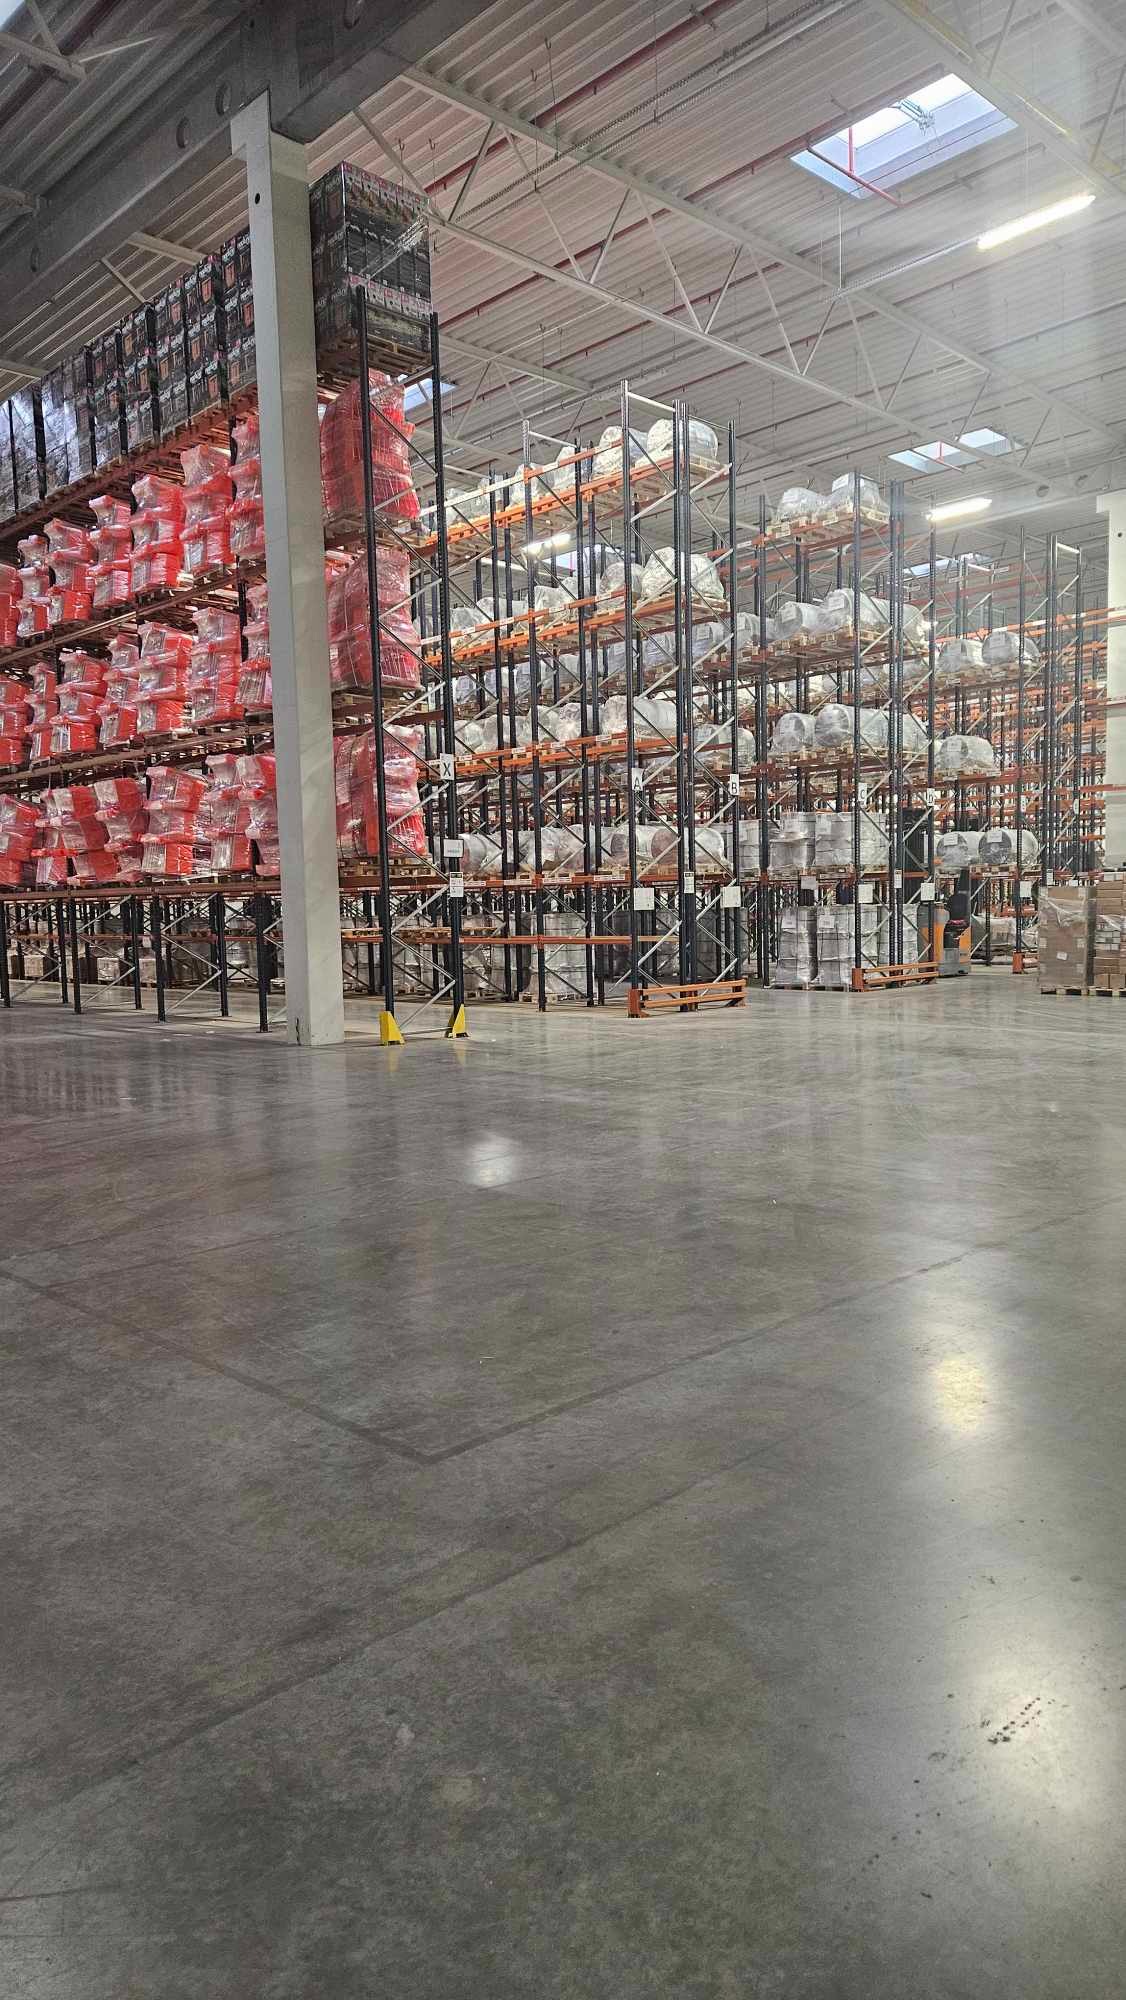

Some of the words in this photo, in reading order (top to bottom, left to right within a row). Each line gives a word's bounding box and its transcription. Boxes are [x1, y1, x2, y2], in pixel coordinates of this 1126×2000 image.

[443, 762, 451, 777] X
[634, 776, 642, 790] A
[731, 782, 738, 795] B
